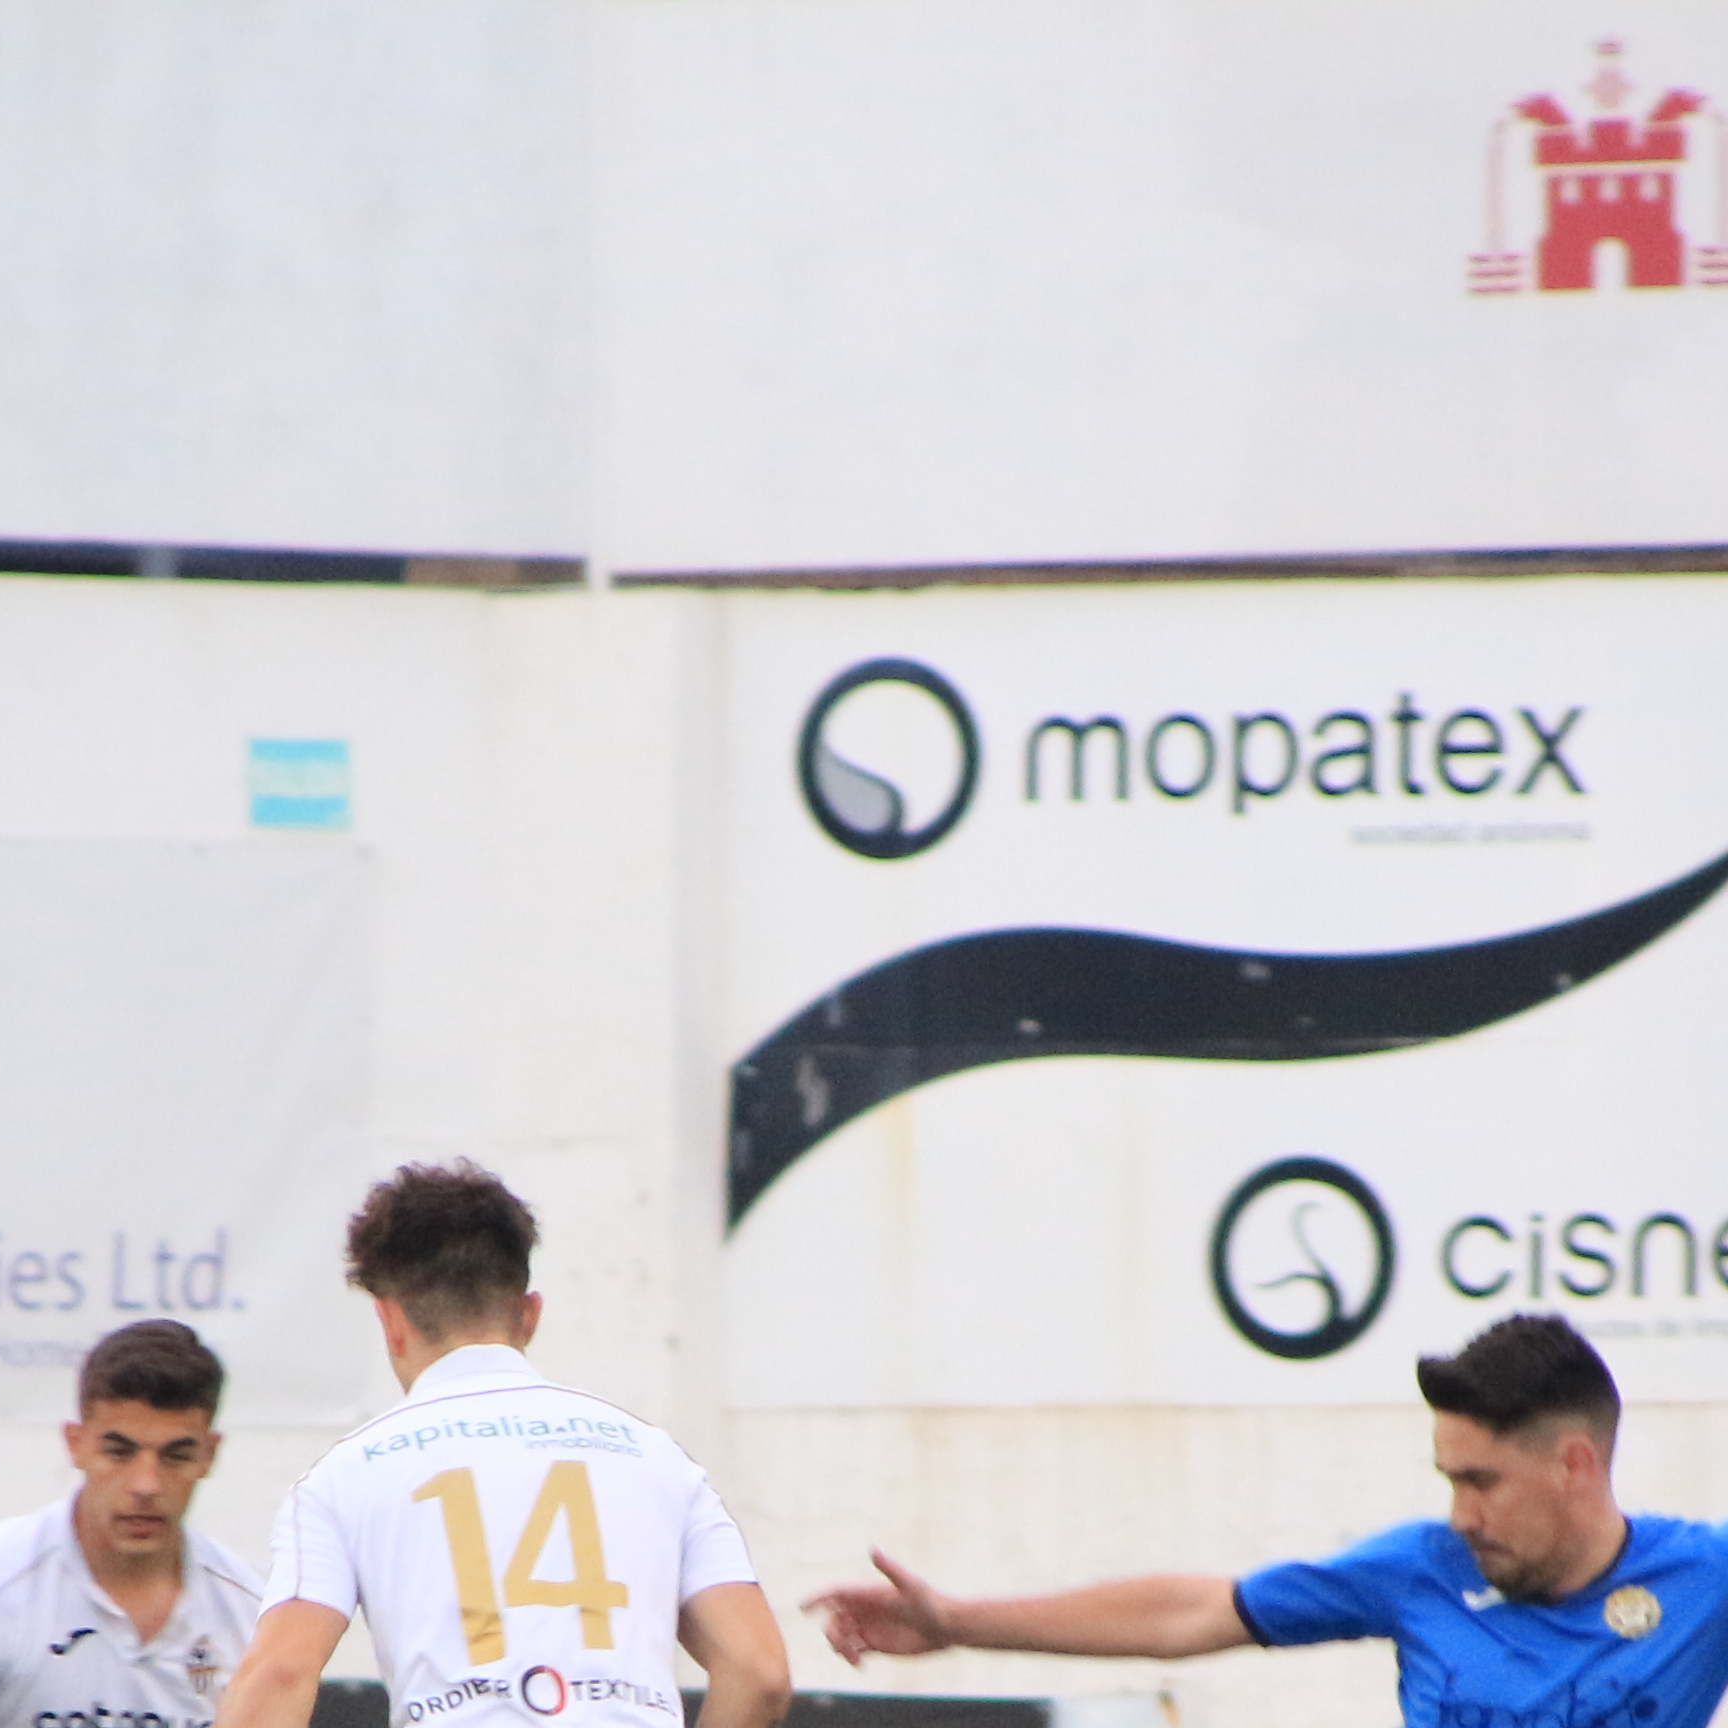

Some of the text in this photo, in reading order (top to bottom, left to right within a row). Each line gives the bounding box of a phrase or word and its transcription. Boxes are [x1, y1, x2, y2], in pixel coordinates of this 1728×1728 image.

[1024, 693, 1586, 814] mopatex
[112, 1229, 249, 1314] Ltd.
[363, 1415, 639, 1462] kapitalia.net
[411, 1460, 630, 1667] 14
